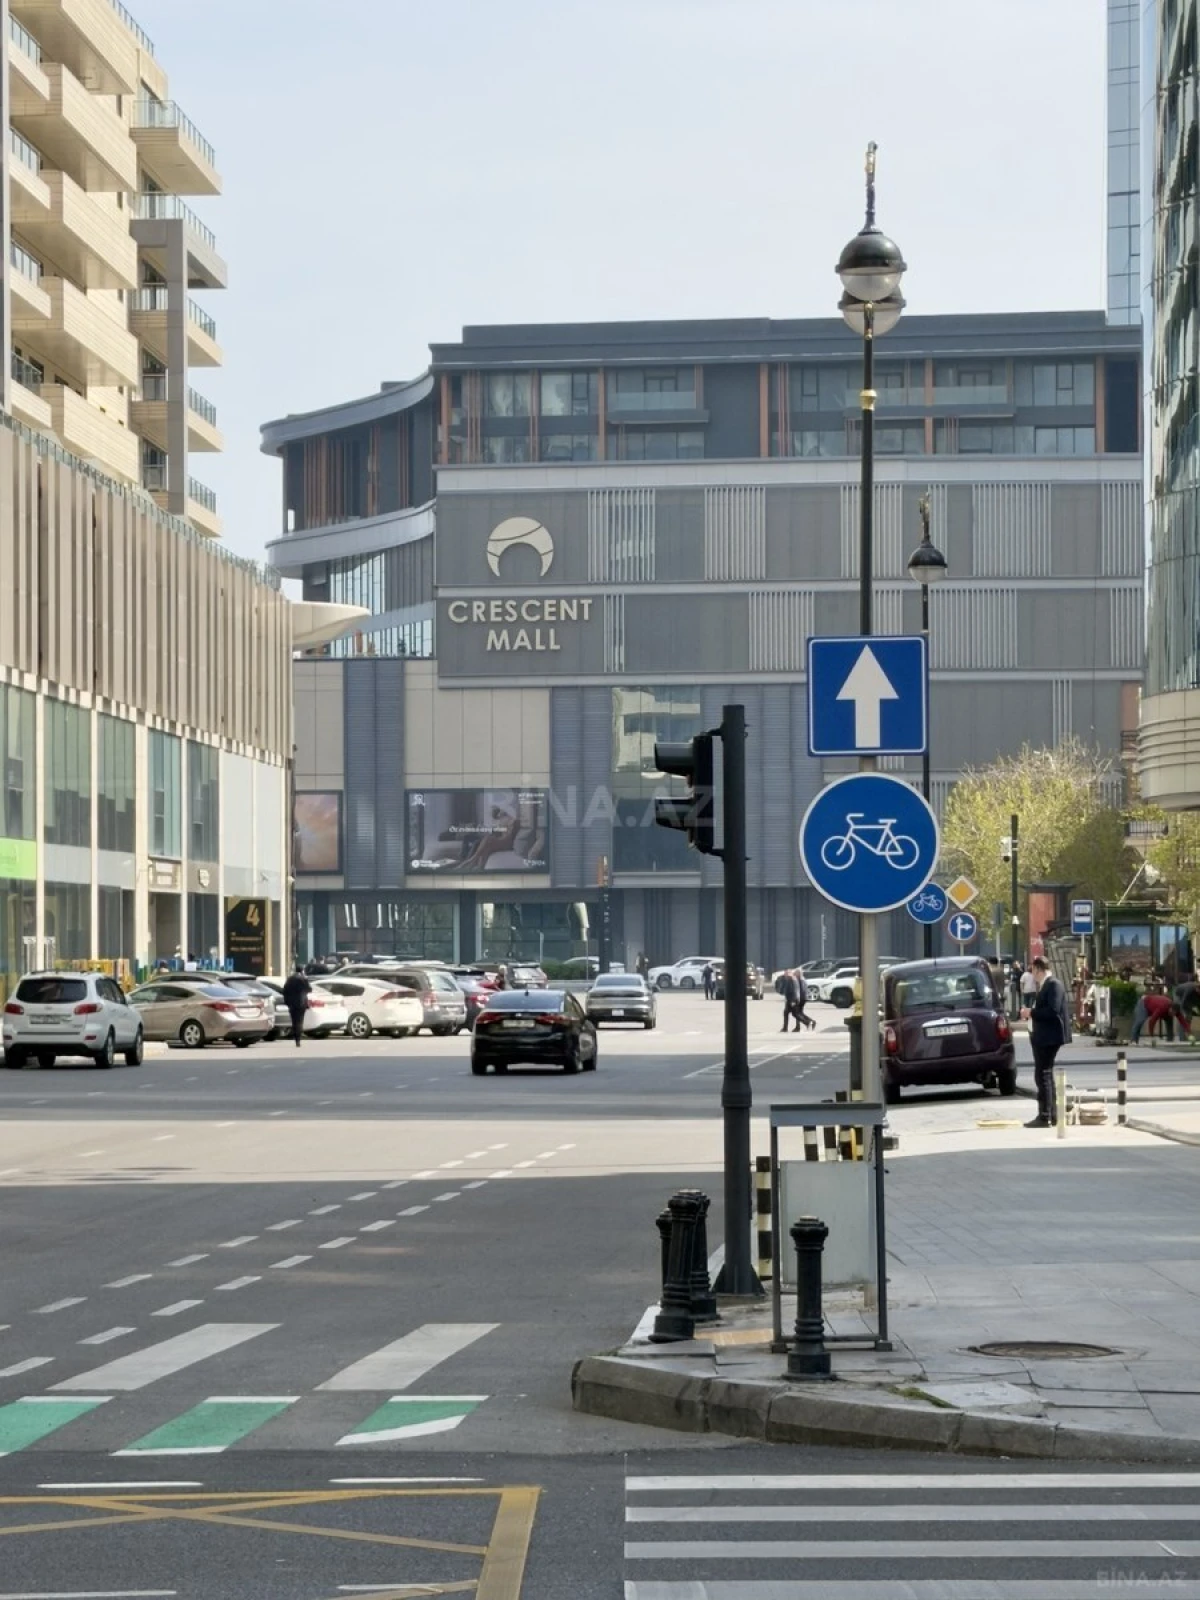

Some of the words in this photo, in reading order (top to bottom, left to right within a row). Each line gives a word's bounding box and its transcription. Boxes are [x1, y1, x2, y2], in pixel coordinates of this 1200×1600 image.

[447, 598, 593, 624] CRESCENT
[486, 628, 562, 652] MALL
[246, 903, 260, 927] 4
